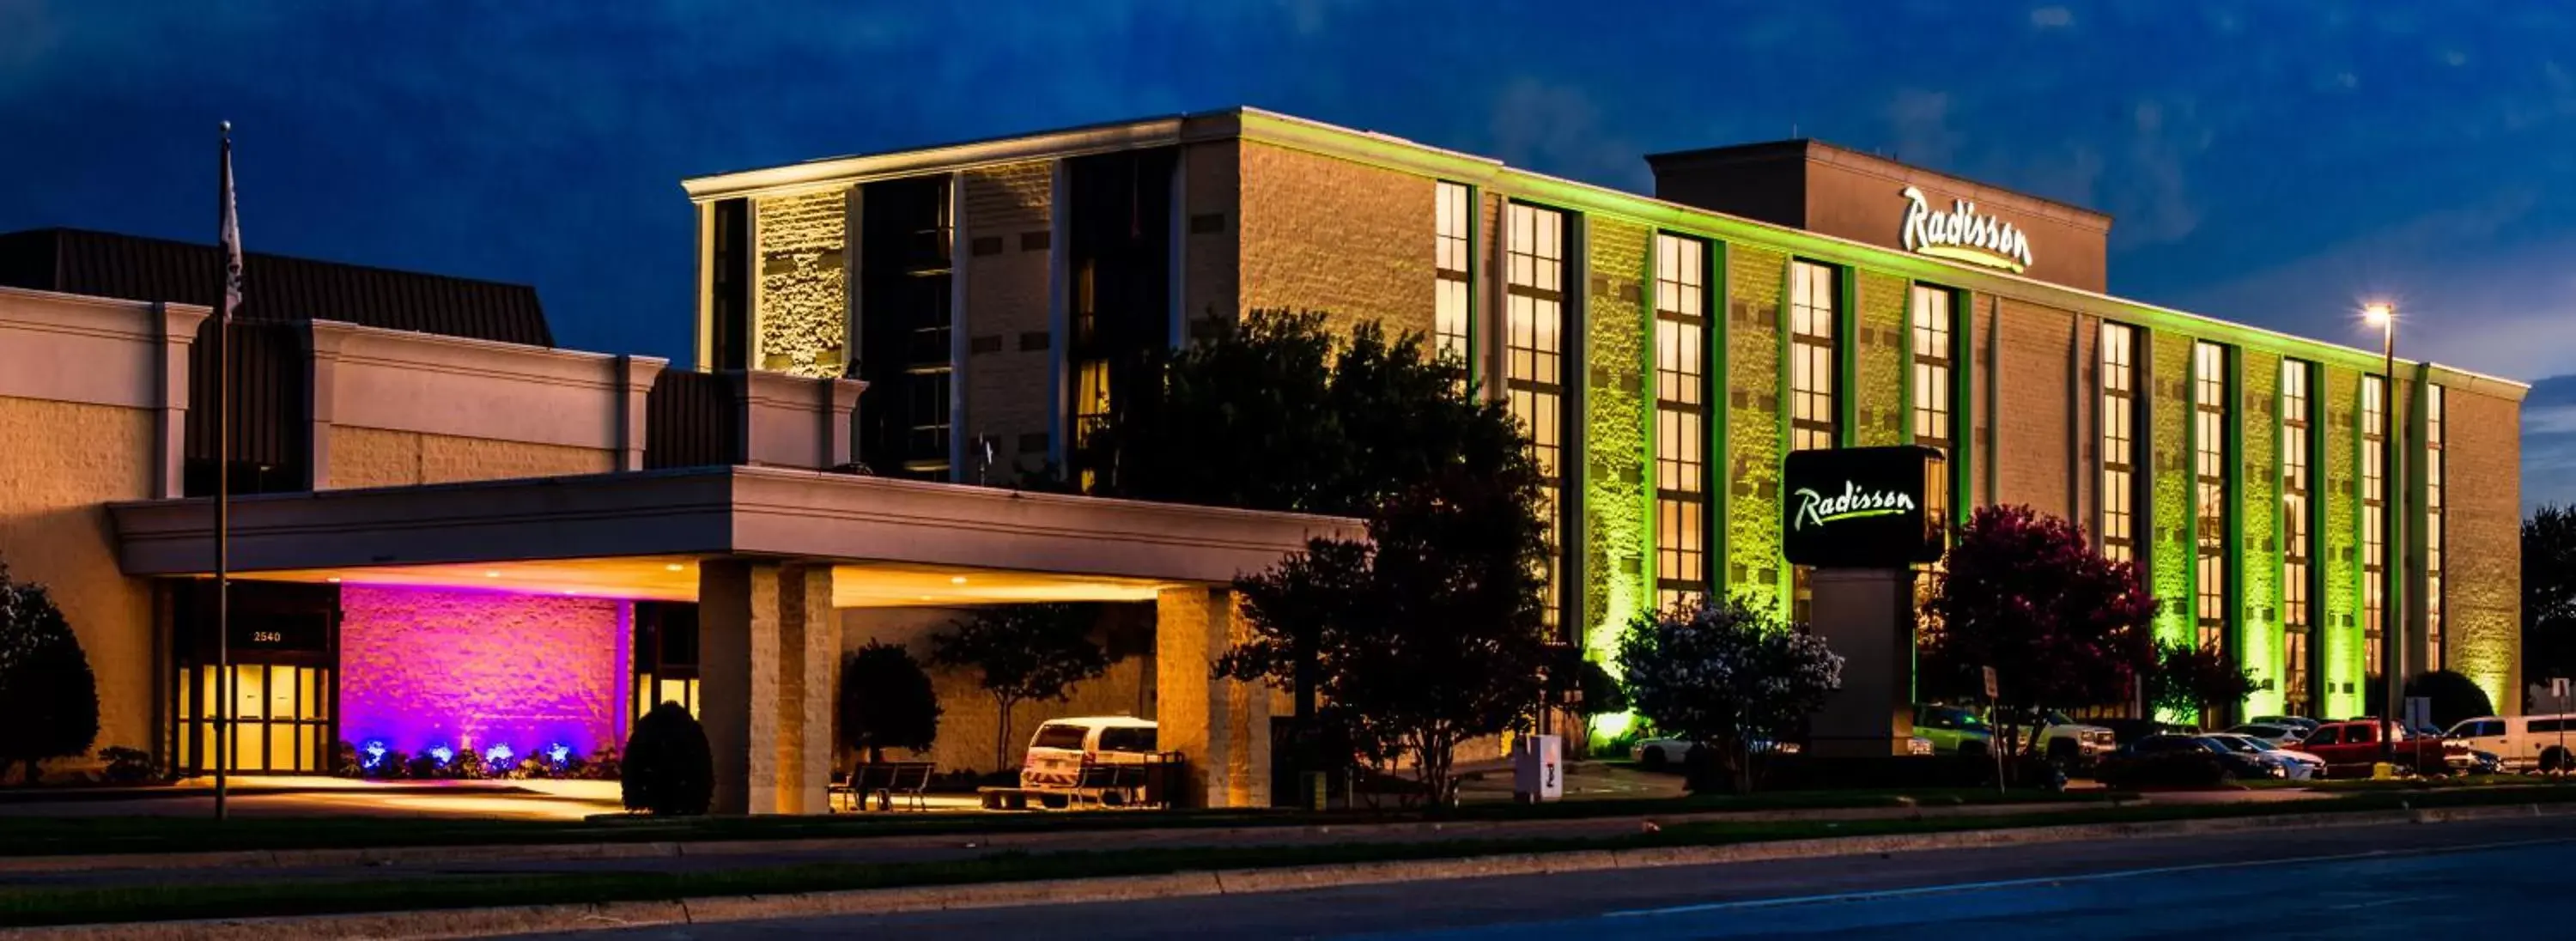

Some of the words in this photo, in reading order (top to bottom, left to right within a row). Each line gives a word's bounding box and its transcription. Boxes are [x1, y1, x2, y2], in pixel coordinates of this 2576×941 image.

[1904, 185, 2032, 266] Radisson
[1795, 480, 1915, 531] Radisson
[254, 631, 281, 642] 2540
